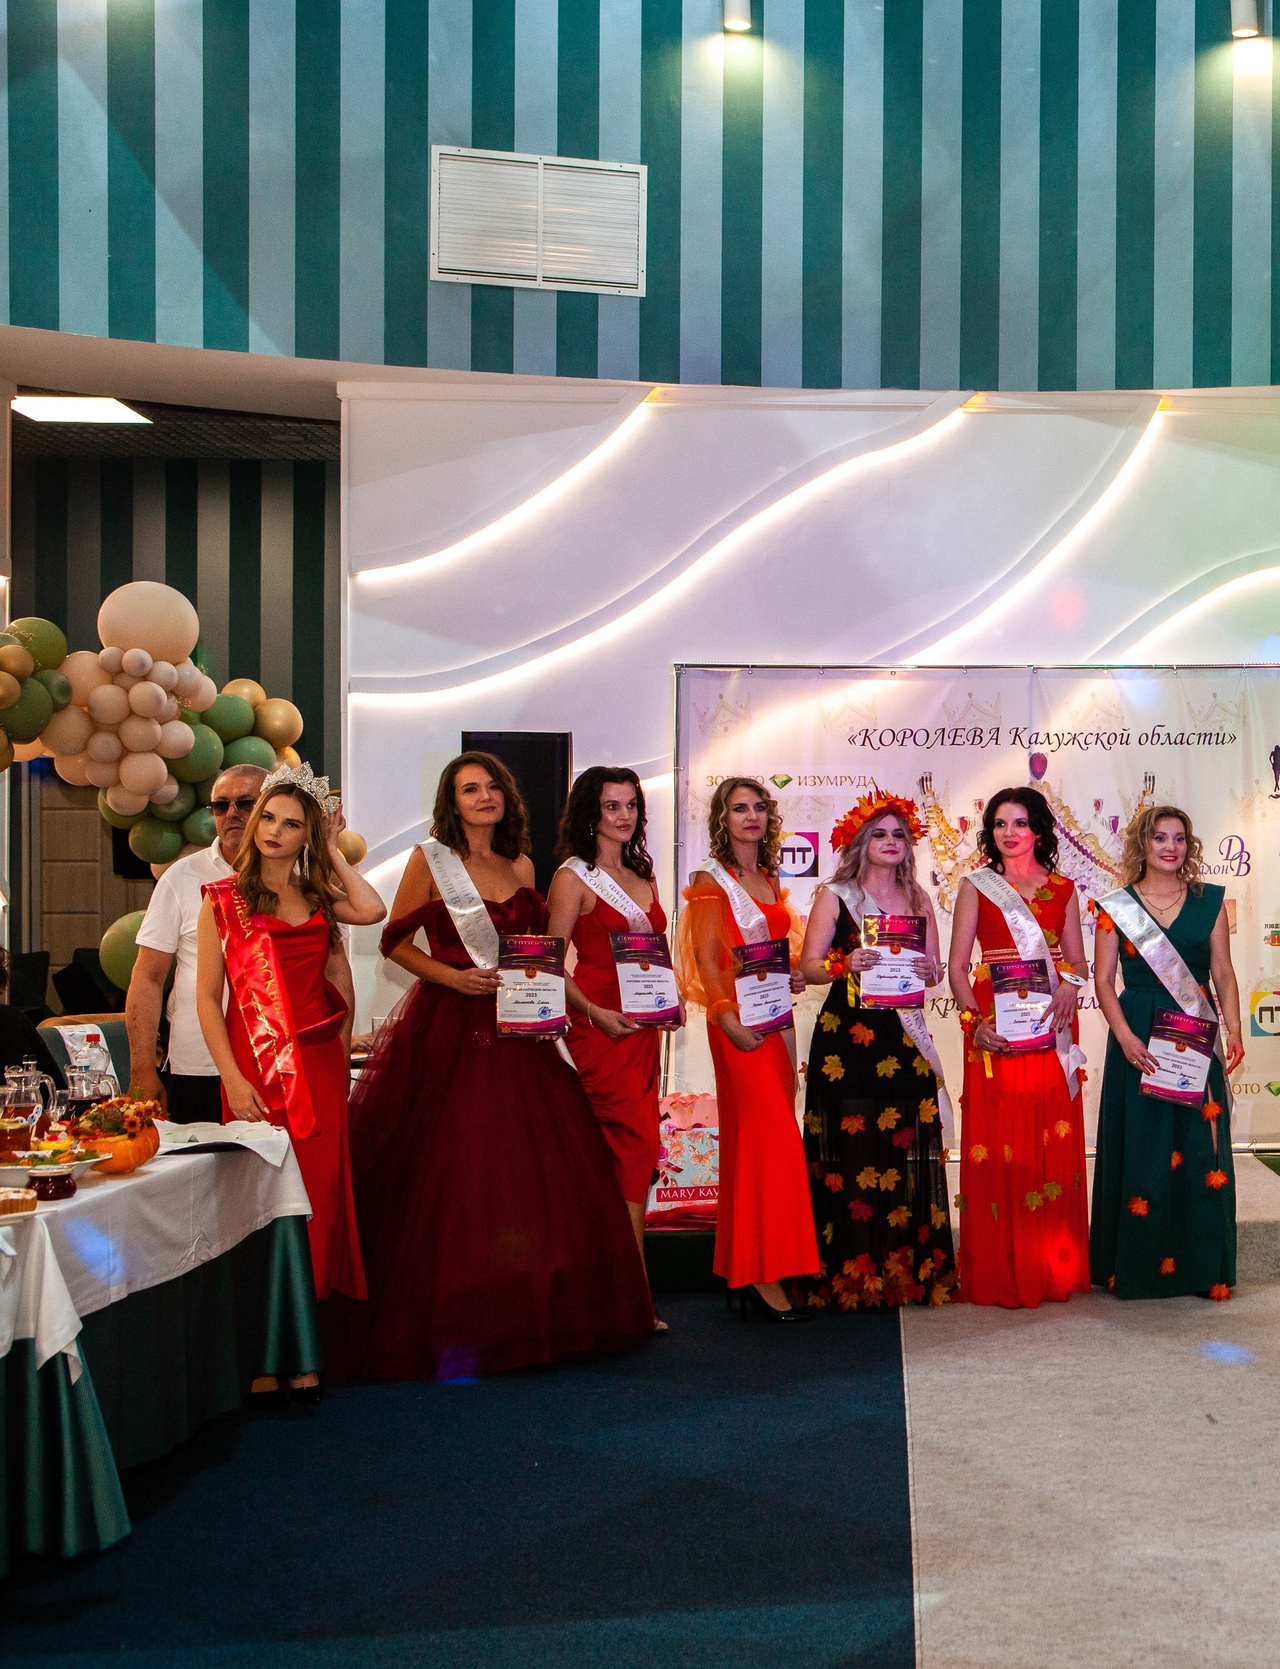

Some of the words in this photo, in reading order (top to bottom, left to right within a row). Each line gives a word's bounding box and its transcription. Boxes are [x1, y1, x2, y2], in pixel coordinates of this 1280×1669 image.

[847, 726, 1002, 749] «КОРОЛЕВА
[1008, 726, 1131, 752] Калужской
[1137, 724, 1237, 746] области»
[798, 776, 877, 788] ИЗУМРУДА
[780, 847, 812, 864] ПТ
[608, 883, 651, 931] ФИНАЛИС
[459, 912, 489, 968] КАЛУЖСК
[1232, 1082, 1260, 1095] ОТО
[660, 1188, 696, 1200] MARY
[700, 1188, 720, 1198] KAY
